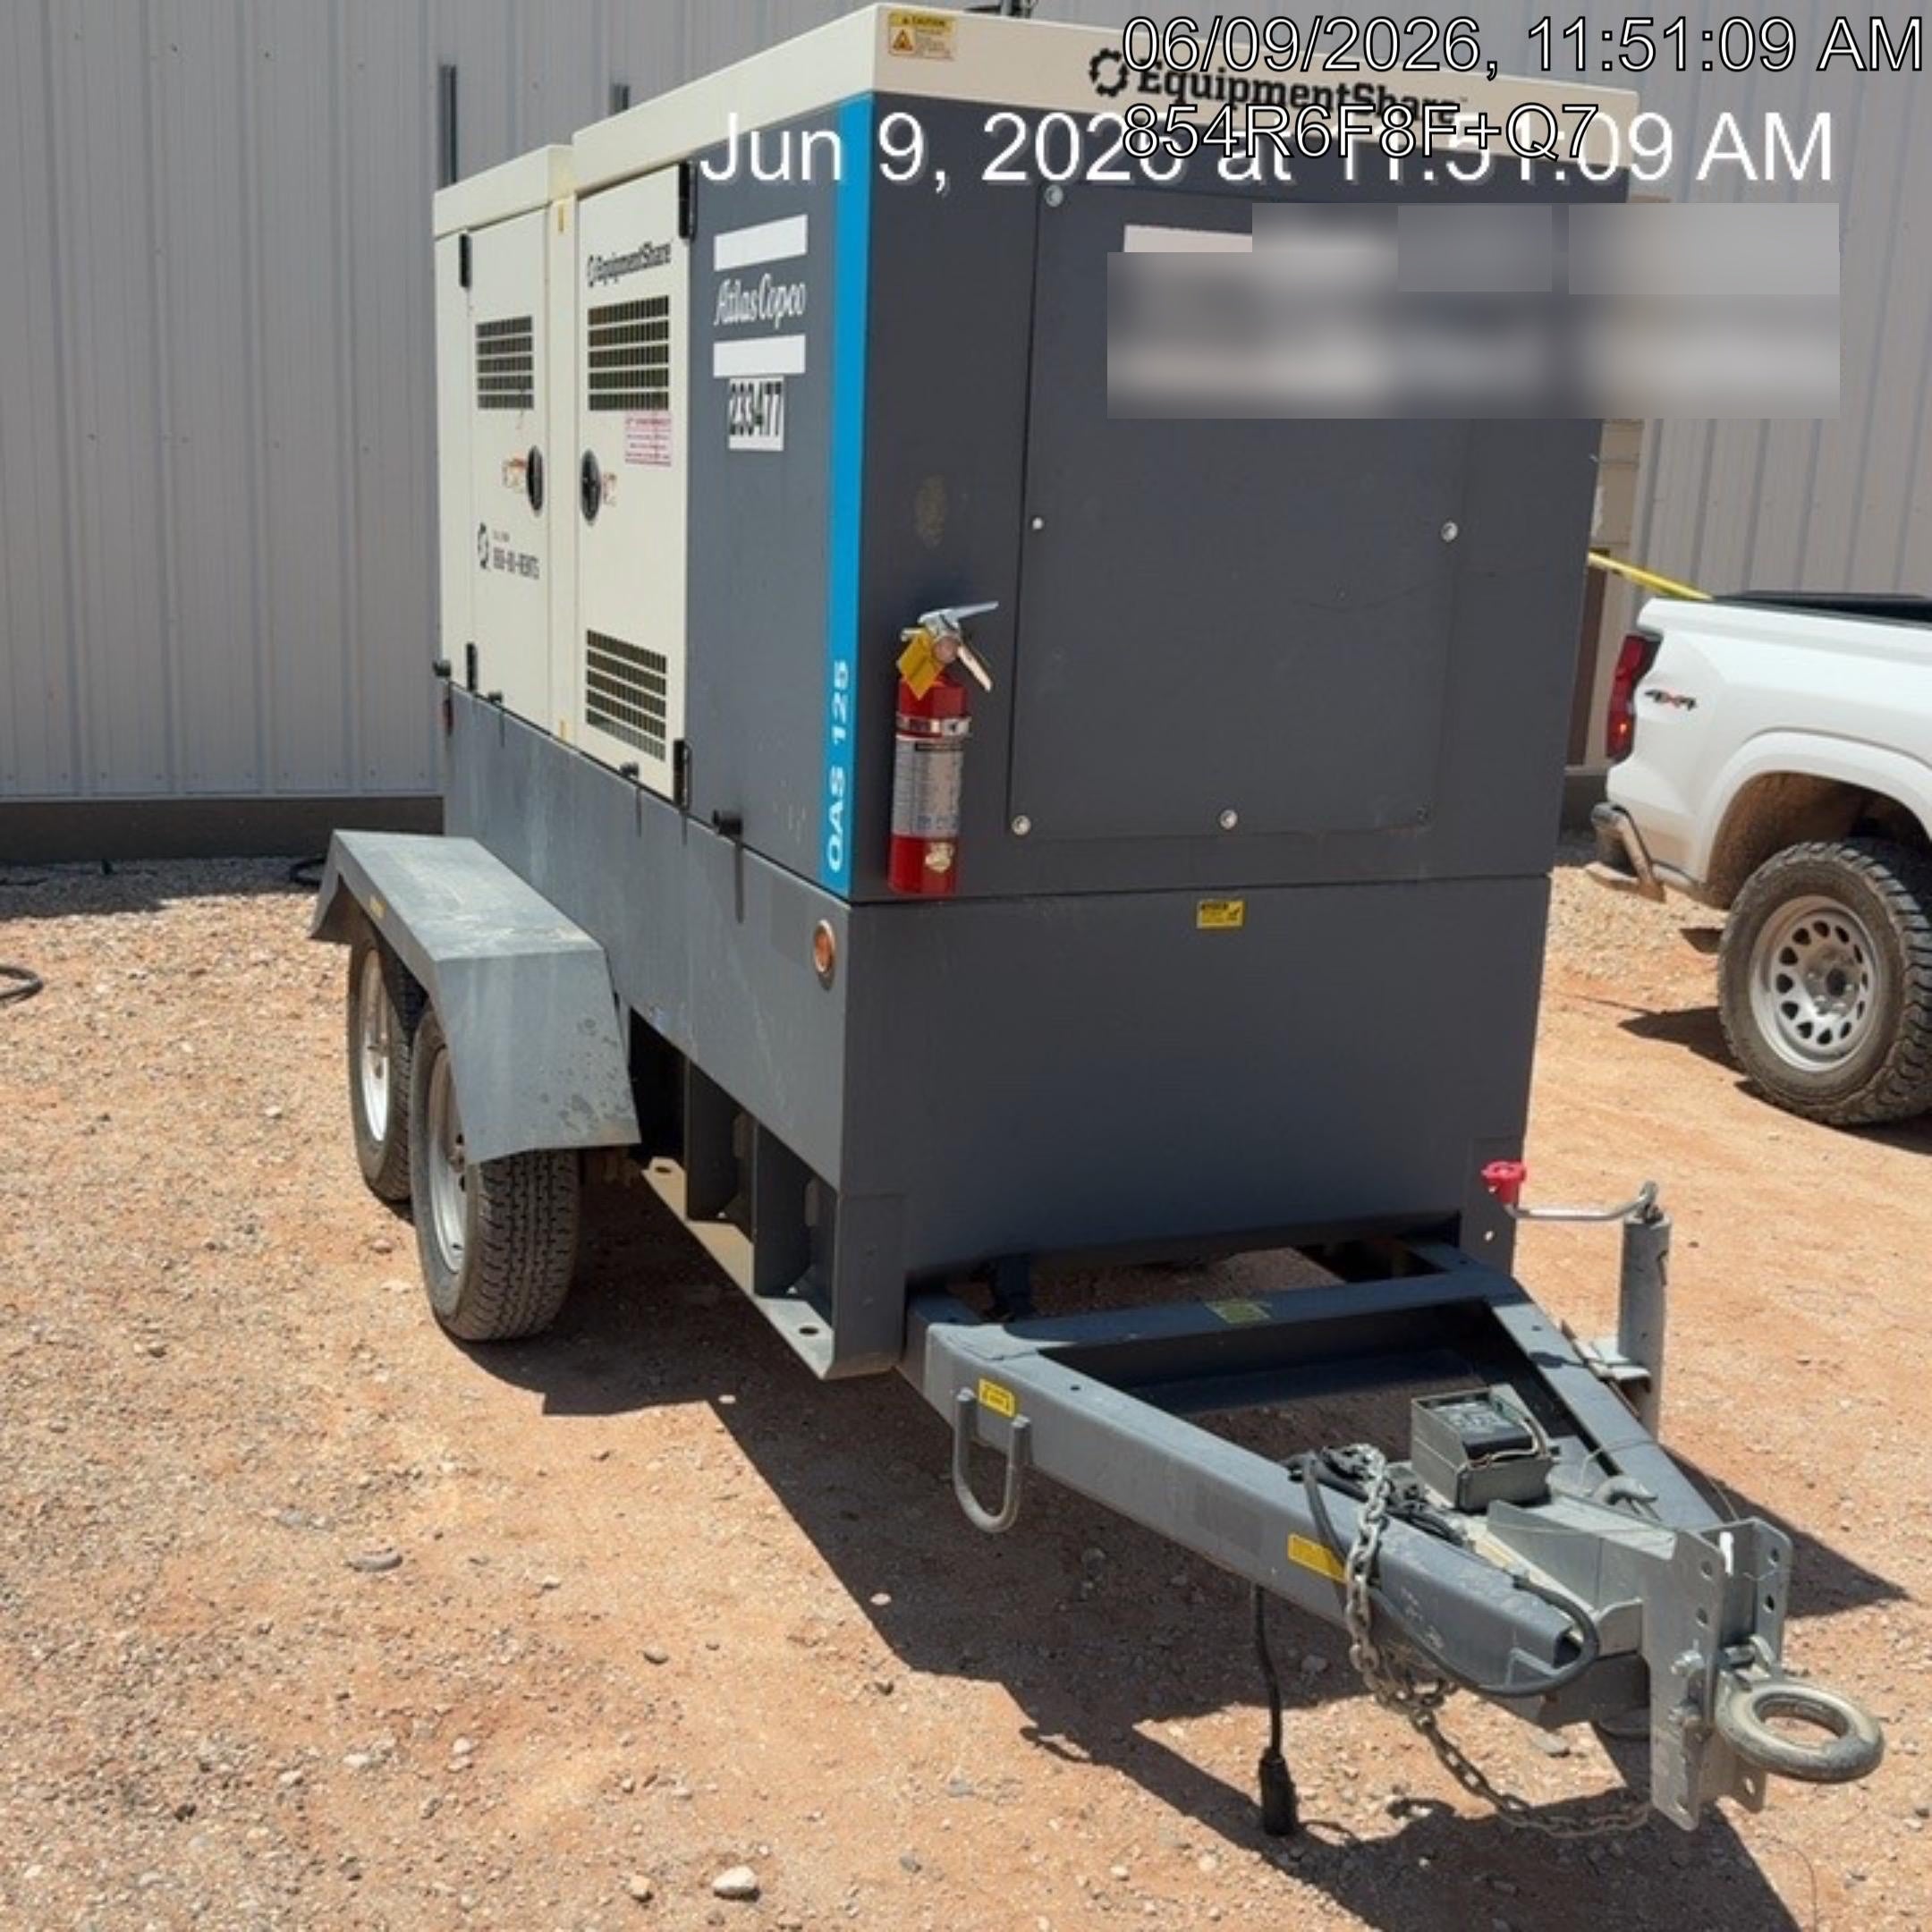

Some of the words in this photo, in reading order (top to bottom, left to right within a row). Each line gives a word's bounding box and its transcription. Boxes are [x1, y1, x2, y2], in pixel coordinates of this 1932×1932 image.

[597, 242, 671, 285] EquipmentShare
[713, 278, 758, 326] Atlas
[758, 272, 808, 330] Copco
[729, 382, 783, 436] 233477
[831, 659, 848, 745] 125
